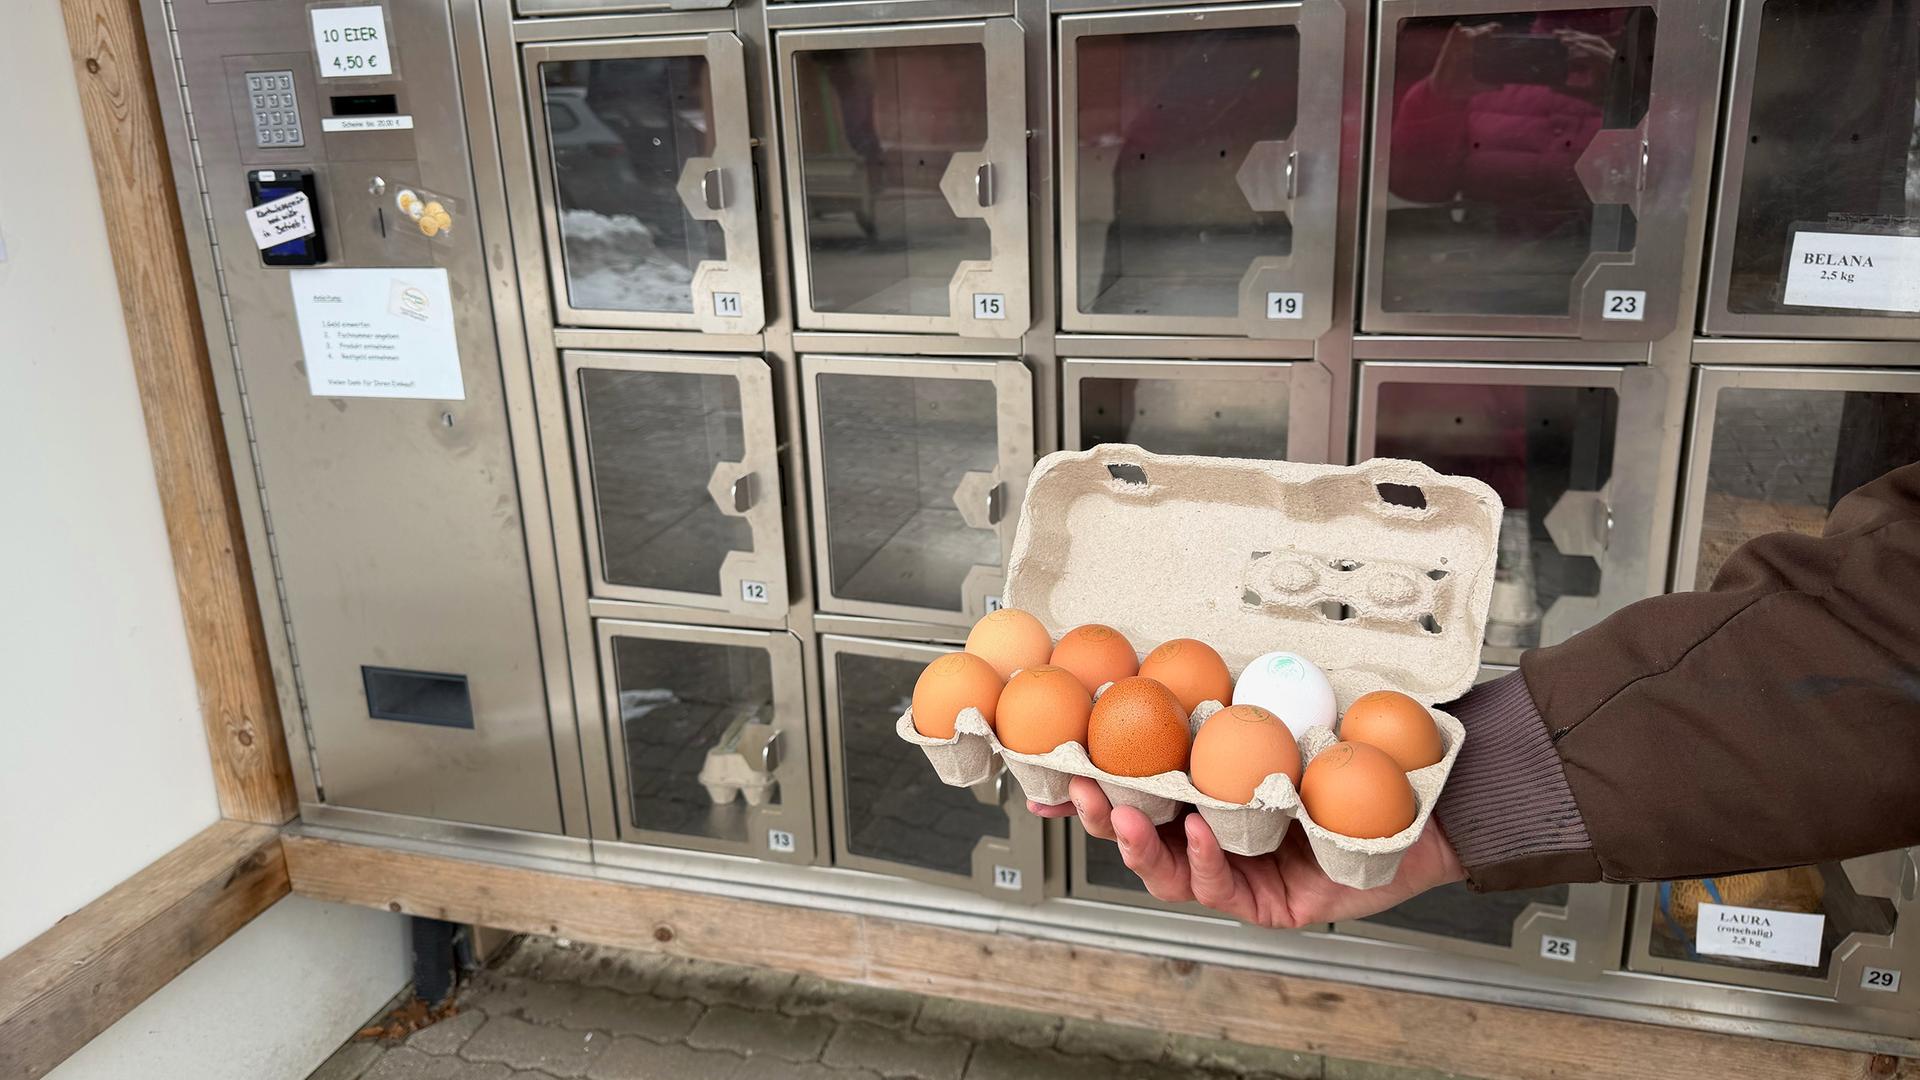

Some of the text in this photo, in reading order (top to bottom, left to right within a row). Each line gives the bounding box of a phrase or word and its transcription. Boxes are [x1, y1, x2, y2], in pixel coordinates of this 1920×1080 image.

[323, 27, 378, 43] 10 EIER
[333, 55, 377, 71] 4,50 €
[1803, 253, 1874, 268] BELANA
[1820, 270, 1855, 283] 2,5 kg
[721, 297, 736, 311] 11
[980, 298, 1000, 314] 15
[1275, 297, 1297, 314] 19
[1610, 297, 1636, 313] 23
[747, 585, 763, 598] 12
[774, 833, 791, 847] 13
[1000, 869, 1017, 884] 17
[1720, 912, 1771, 927] LAURA
[1717, 924, 1773, 939] (rotschalig)
[1547, 940, 1571, 956] 25
[1732, 935, 1762, 948] 2,5 kg
[1868, 970, 1894, 987] 29
